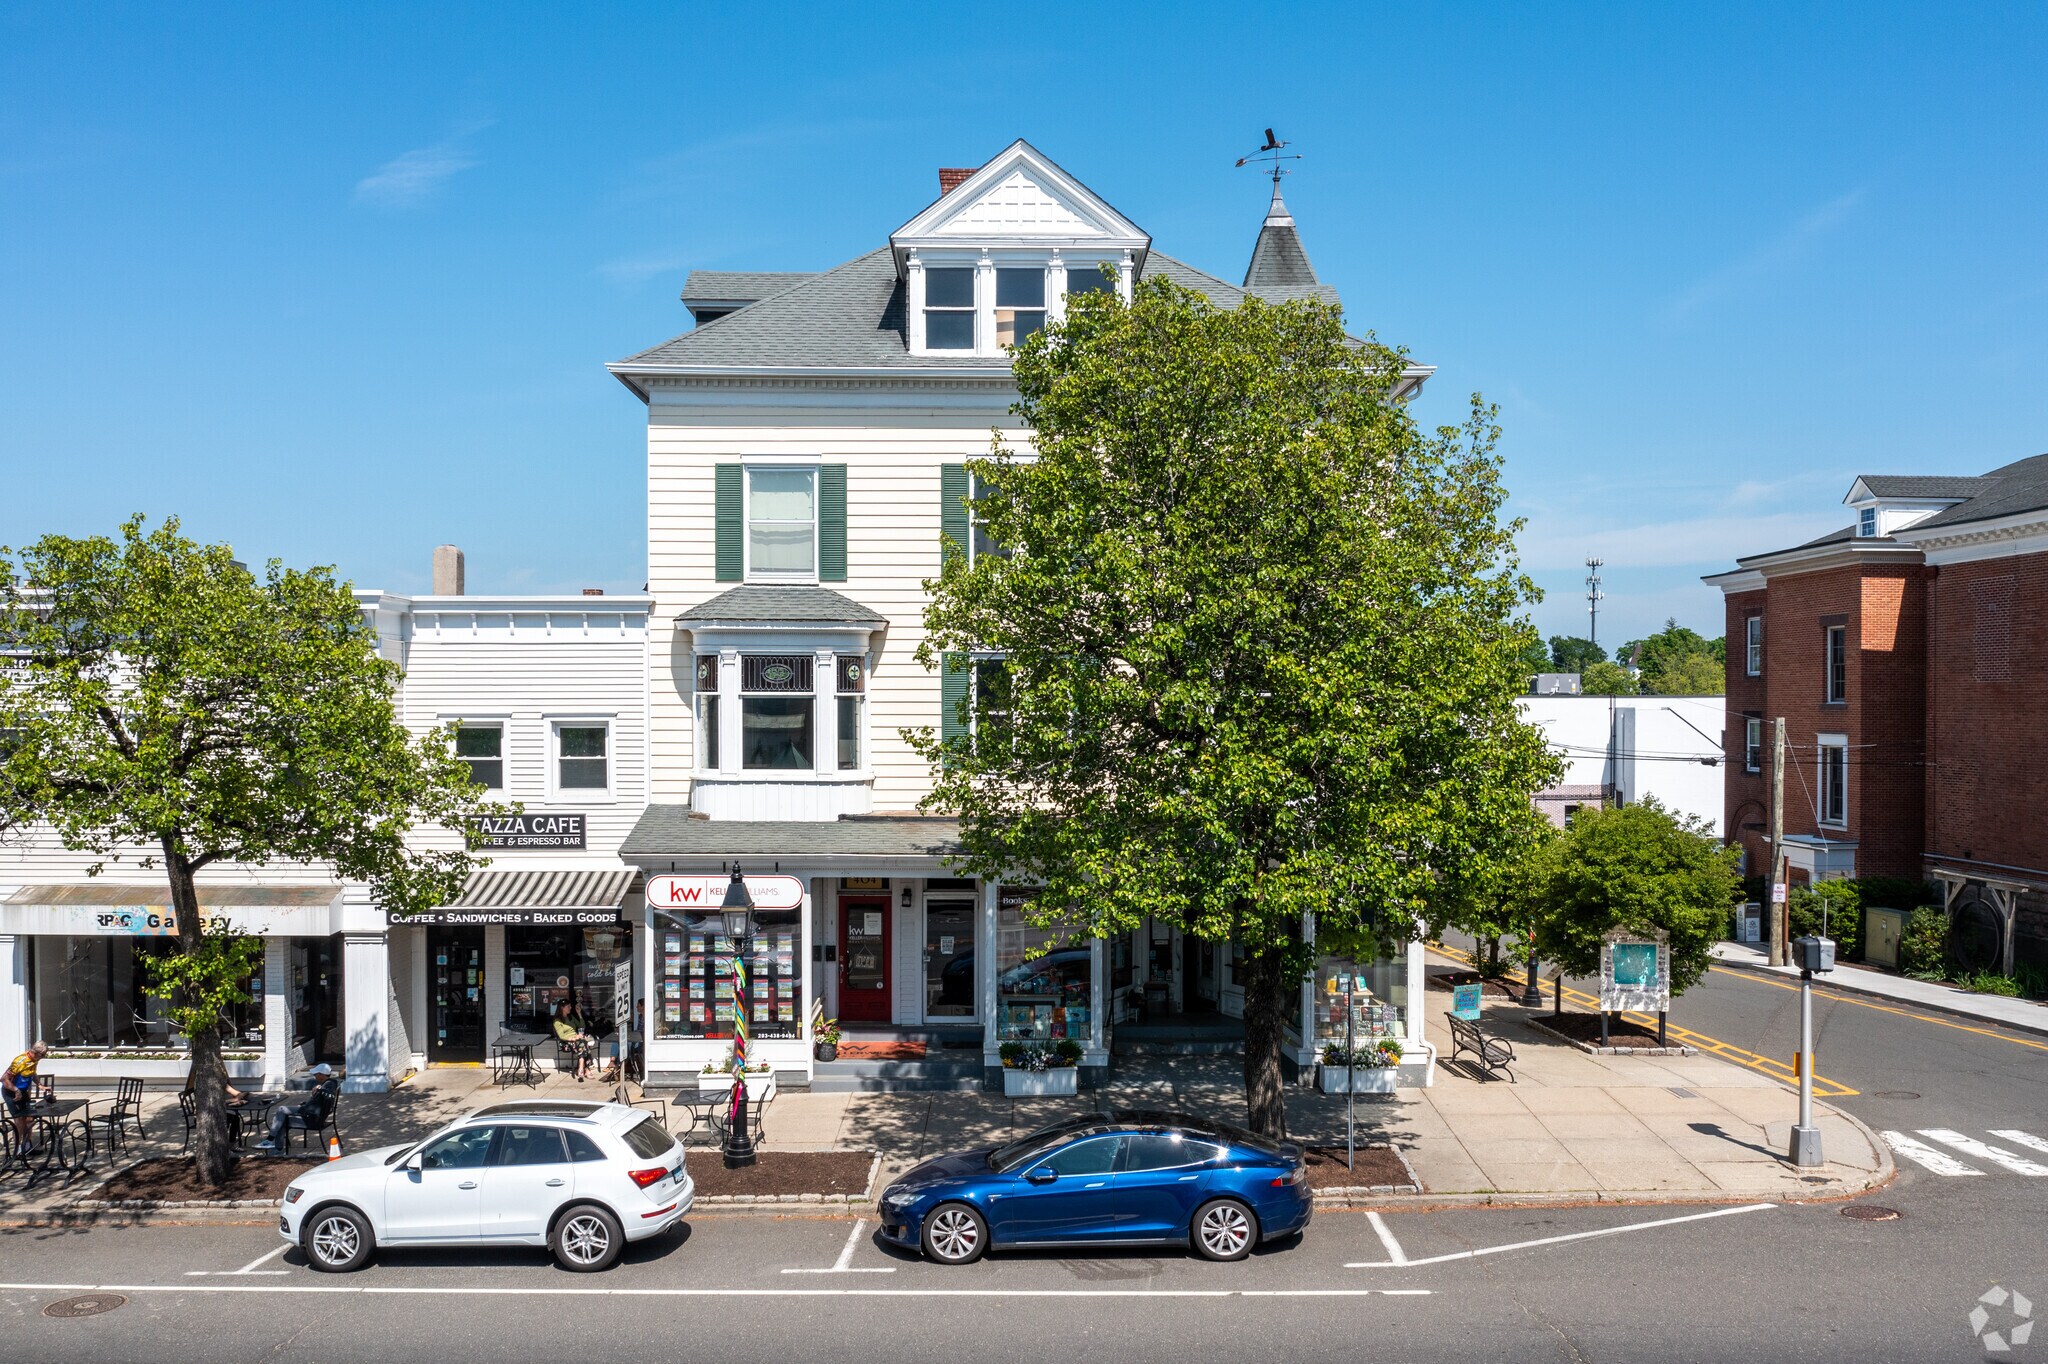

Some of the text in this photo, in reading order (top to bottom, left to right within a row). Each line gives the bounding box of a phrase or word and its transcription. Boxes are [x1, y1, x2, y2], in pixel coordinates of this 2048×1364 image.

[532, 817, 580, 833] CAFE
[670, 881, 702, 902] kw
[147, 914, 231, 931] Gaery
[447, 913, 521, 923] SANDWICHES
[533, 913, 573, 923] BAKED
[577, 913, 616, 923] GOODS
[617, 968, 629, 982] SPEED
[617, 993, 629, 1018] 25
